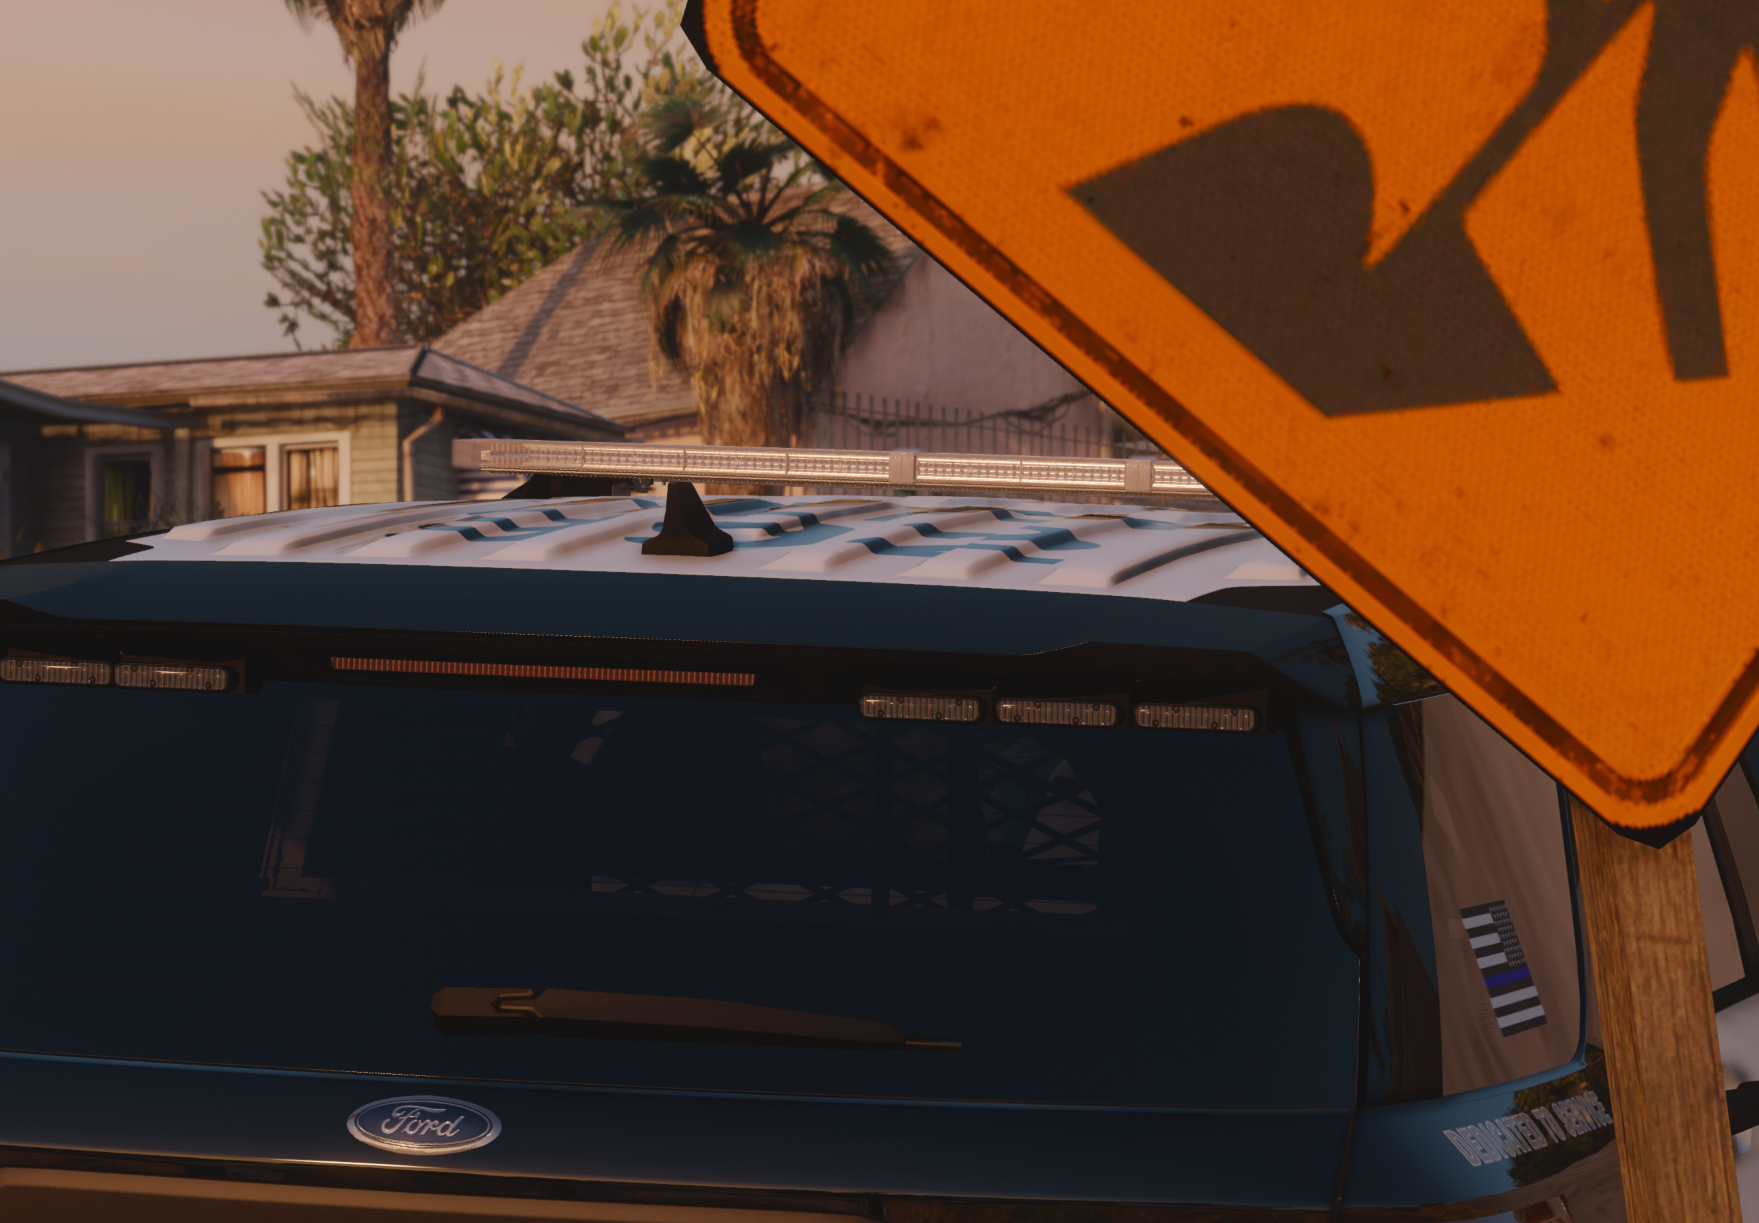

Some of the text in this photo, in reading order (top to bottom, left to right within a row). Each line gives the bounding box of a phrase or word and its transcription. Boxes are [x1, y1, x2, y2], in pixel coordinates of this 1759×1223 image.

[380, 1104, 466, 1137] Ford
[1442, 1090, 1614, 1167] DEDICATED TO SERVICE
